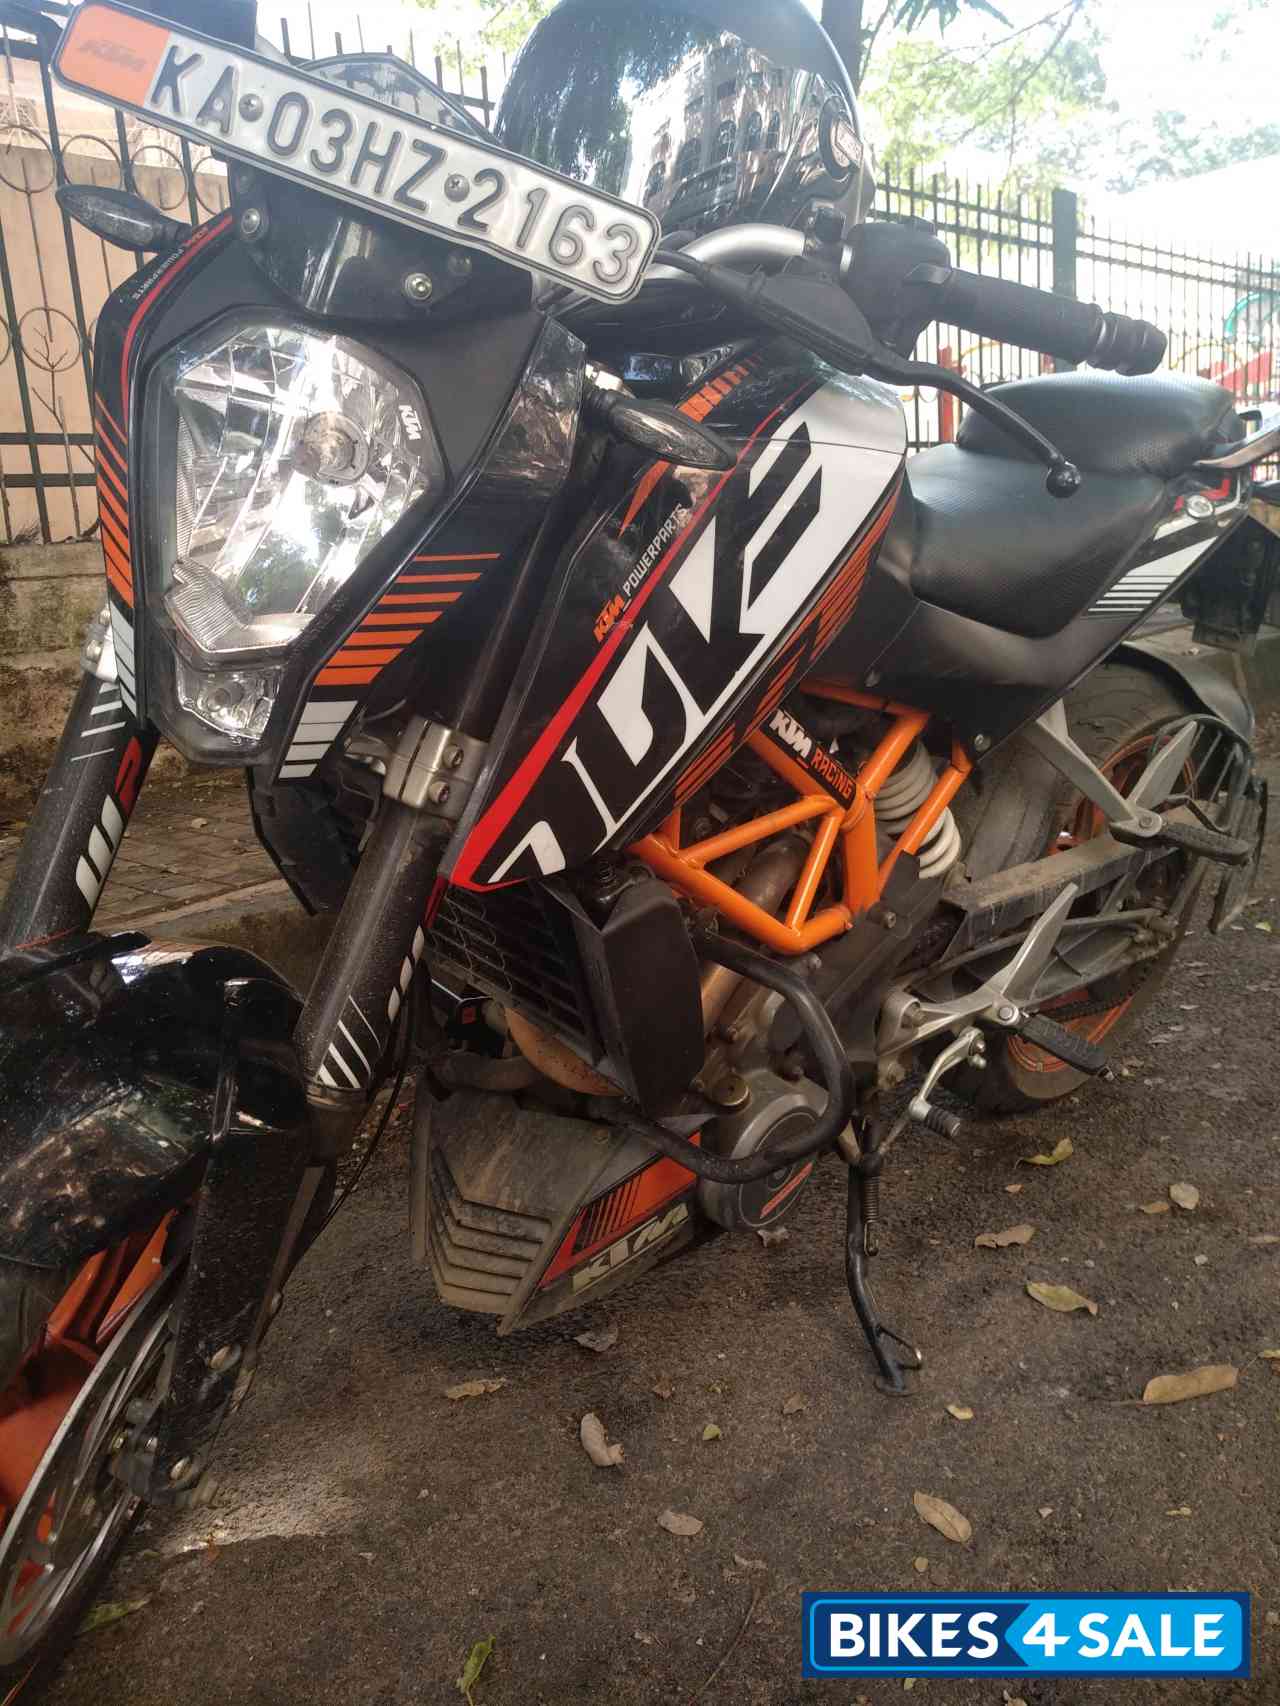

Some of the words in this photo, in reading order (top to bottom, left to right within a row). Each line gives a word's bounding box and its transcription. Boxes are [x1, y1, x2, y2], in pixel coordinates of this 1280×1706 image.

[150, 43, 234, 138] KA
[457, 167, 641, 285] 2163
[398, 404, 423, 441] KTM
[768, 708, 813, 759] KTM
